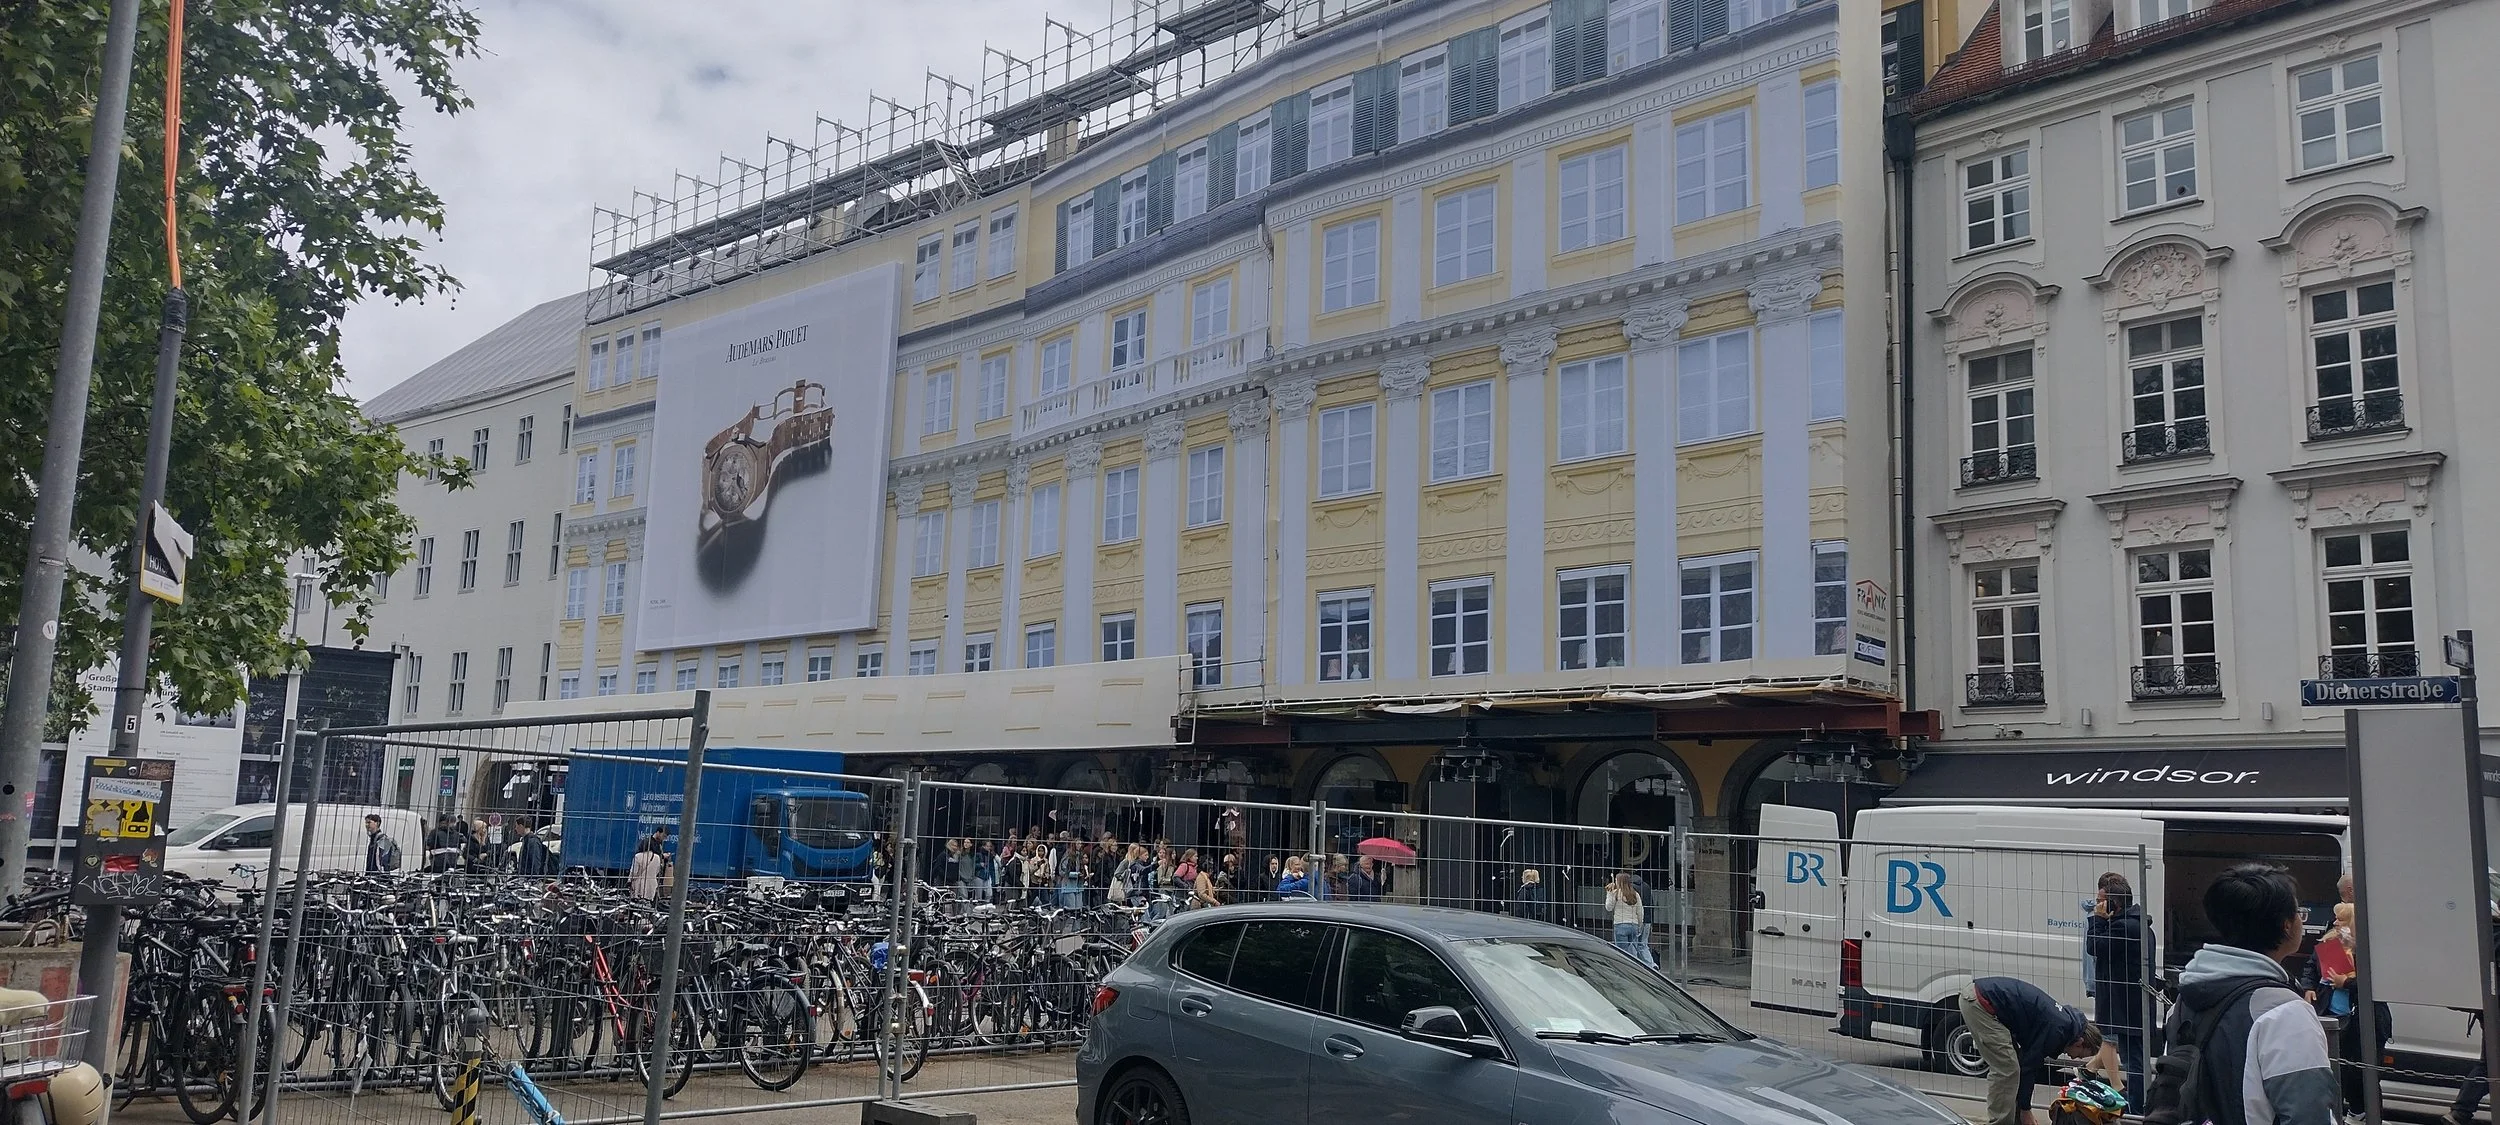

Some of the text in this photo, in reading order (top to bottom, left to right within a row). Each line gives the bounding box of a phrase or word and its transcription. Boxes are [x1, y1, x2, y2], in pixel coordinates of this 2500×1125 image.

[725, 325, 808, 363] AUDEMARS PIGUET
[2315, 679, 2444, 701] Dienerstraße
[127, 717, 136, 731] 5
[1786, 851, 1828, 887] BR
[1886, 859, 1954, 918] BR
[1791, 977, 1827, 989] MAN
